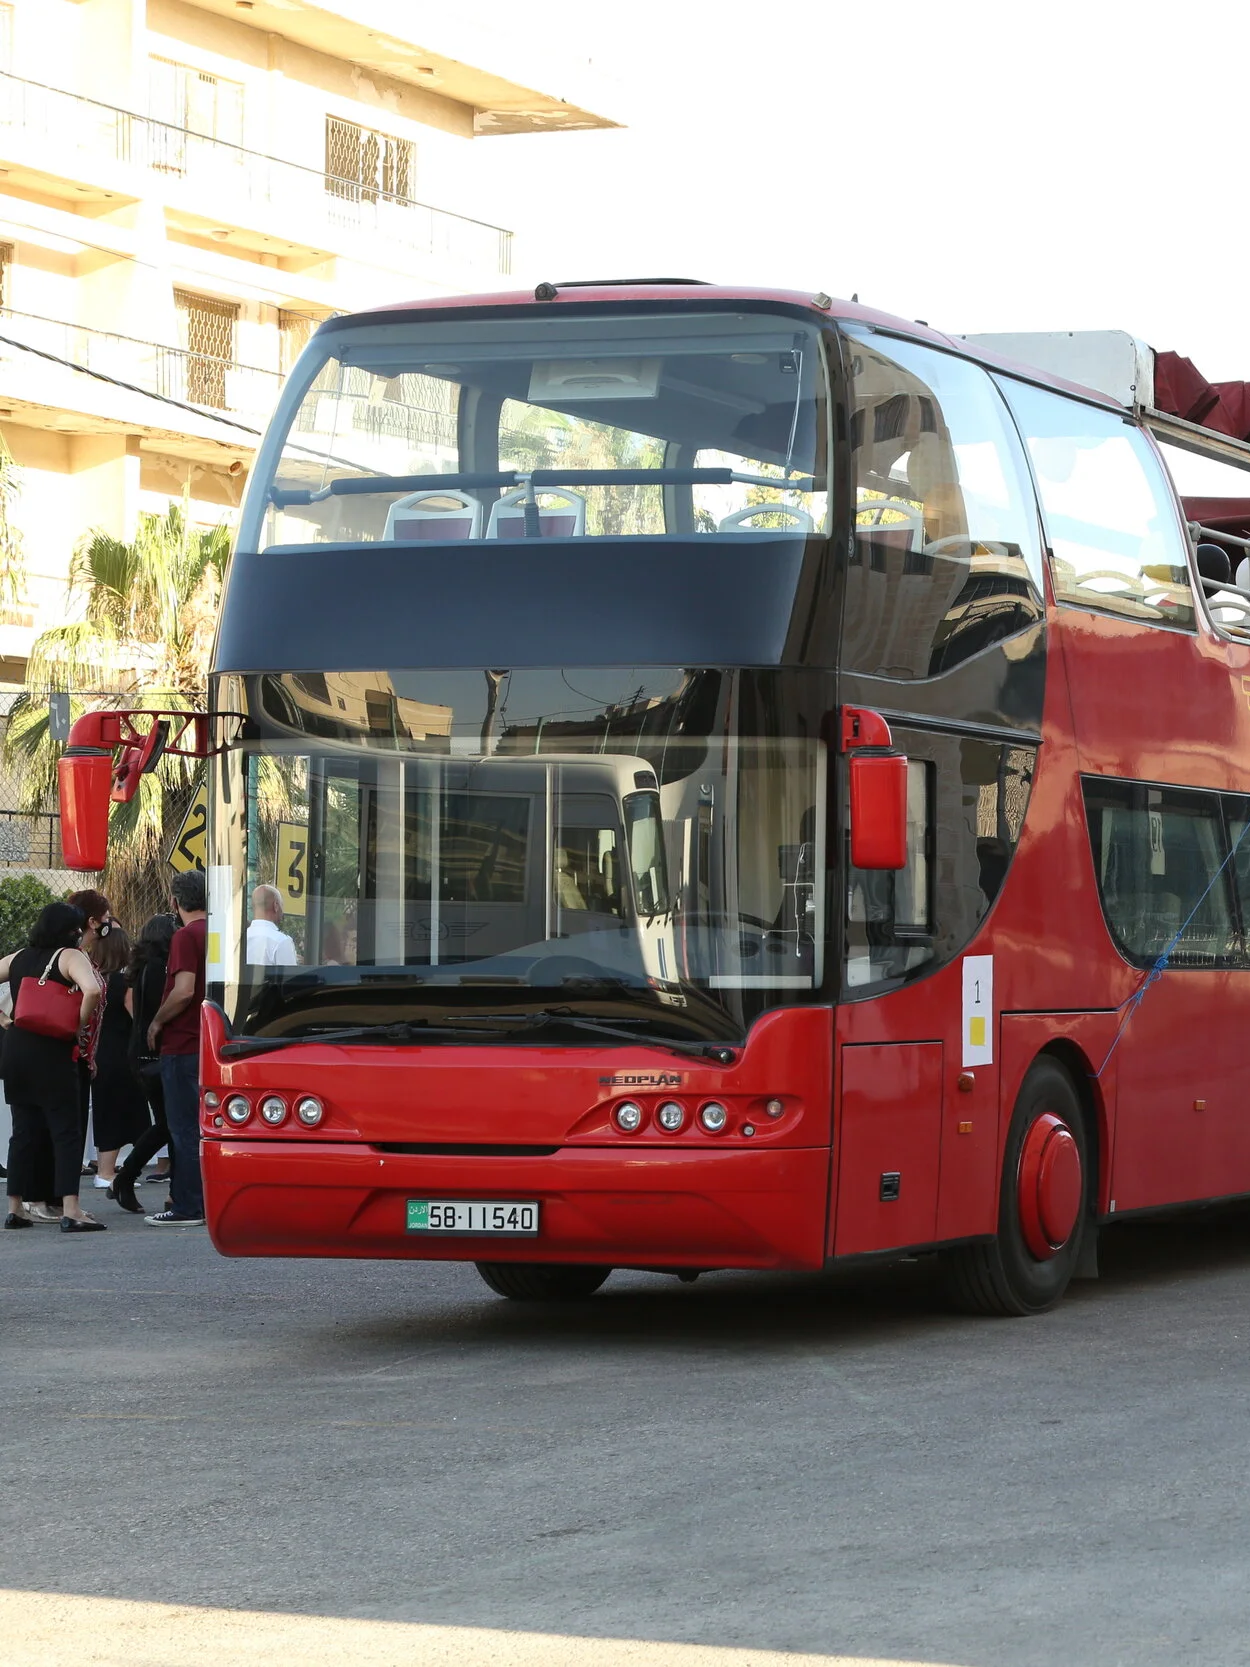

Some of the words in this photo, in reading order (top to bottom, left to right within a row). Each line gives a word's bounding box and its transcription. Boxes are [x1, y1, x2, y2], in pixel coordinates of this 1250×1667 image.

[288, 841, 306, 899] 3
[974, 980, 981, 1004] 1
[599, 1074, 682, 1086] NEOPLAN
